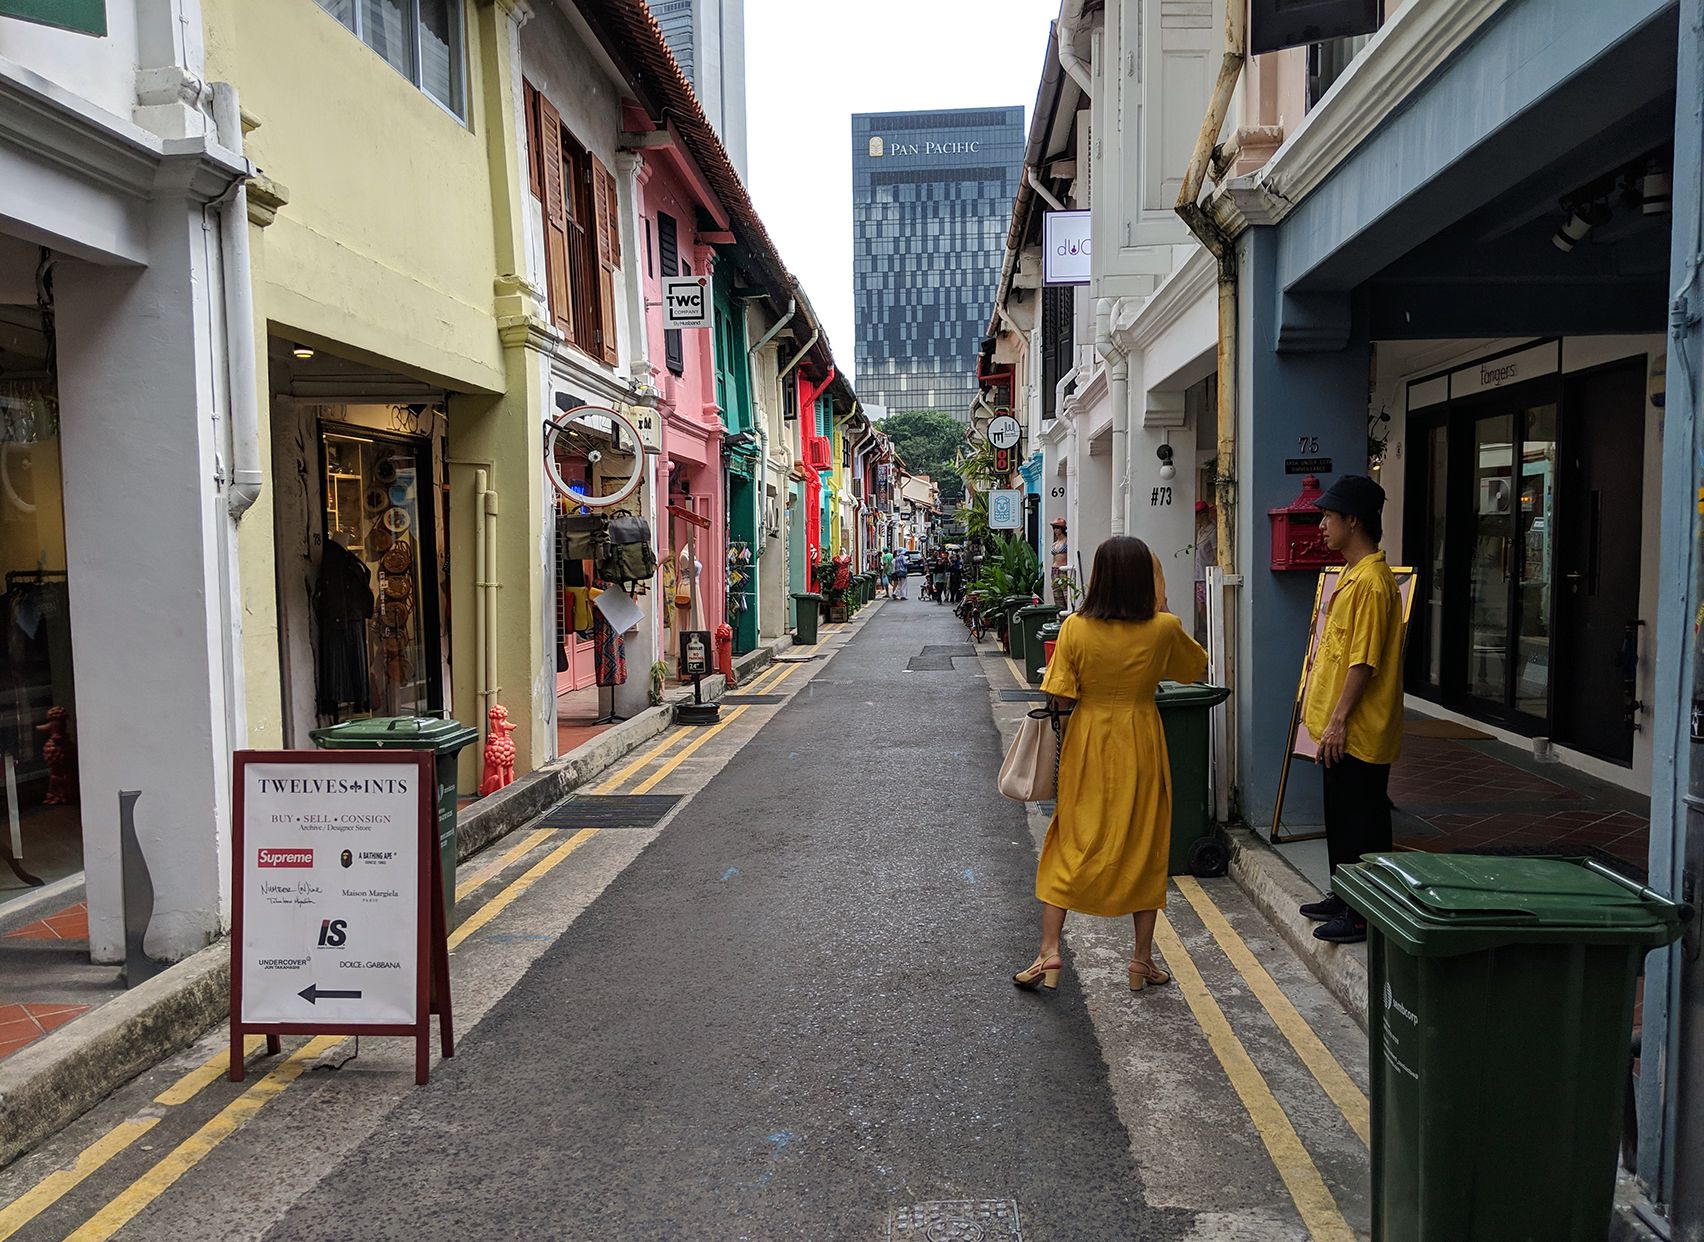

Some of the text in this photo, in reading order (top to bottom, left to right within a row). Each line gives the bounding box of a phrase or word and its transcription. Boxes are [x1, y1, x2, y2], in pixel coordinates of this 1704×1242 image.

[891, 141, 980, 156] PAN PACIFIC
[666, 295, 701, 307] TWC
[1298, 436, 1319, 454] 75
[1051, 487, 1065, 498] 69
[1151, 487, 1172, 506] #73
[271, 814, 391, 824] BUY SELL CONSIGN
[298, 824, 323, 832] Archive
[327, 824, 354, 833] Designer
[355, 824, 372, 832] Store
[259, 850, 312, 866] Supreme
[363, 852, 383, 860] BATHING
[383, 852, 392, 860] APE
[342, 889, 399, 898] Maison Margiela
[339, 961, 362, 969] DOLCE
[366, 961, 401, 970] GABBANA
